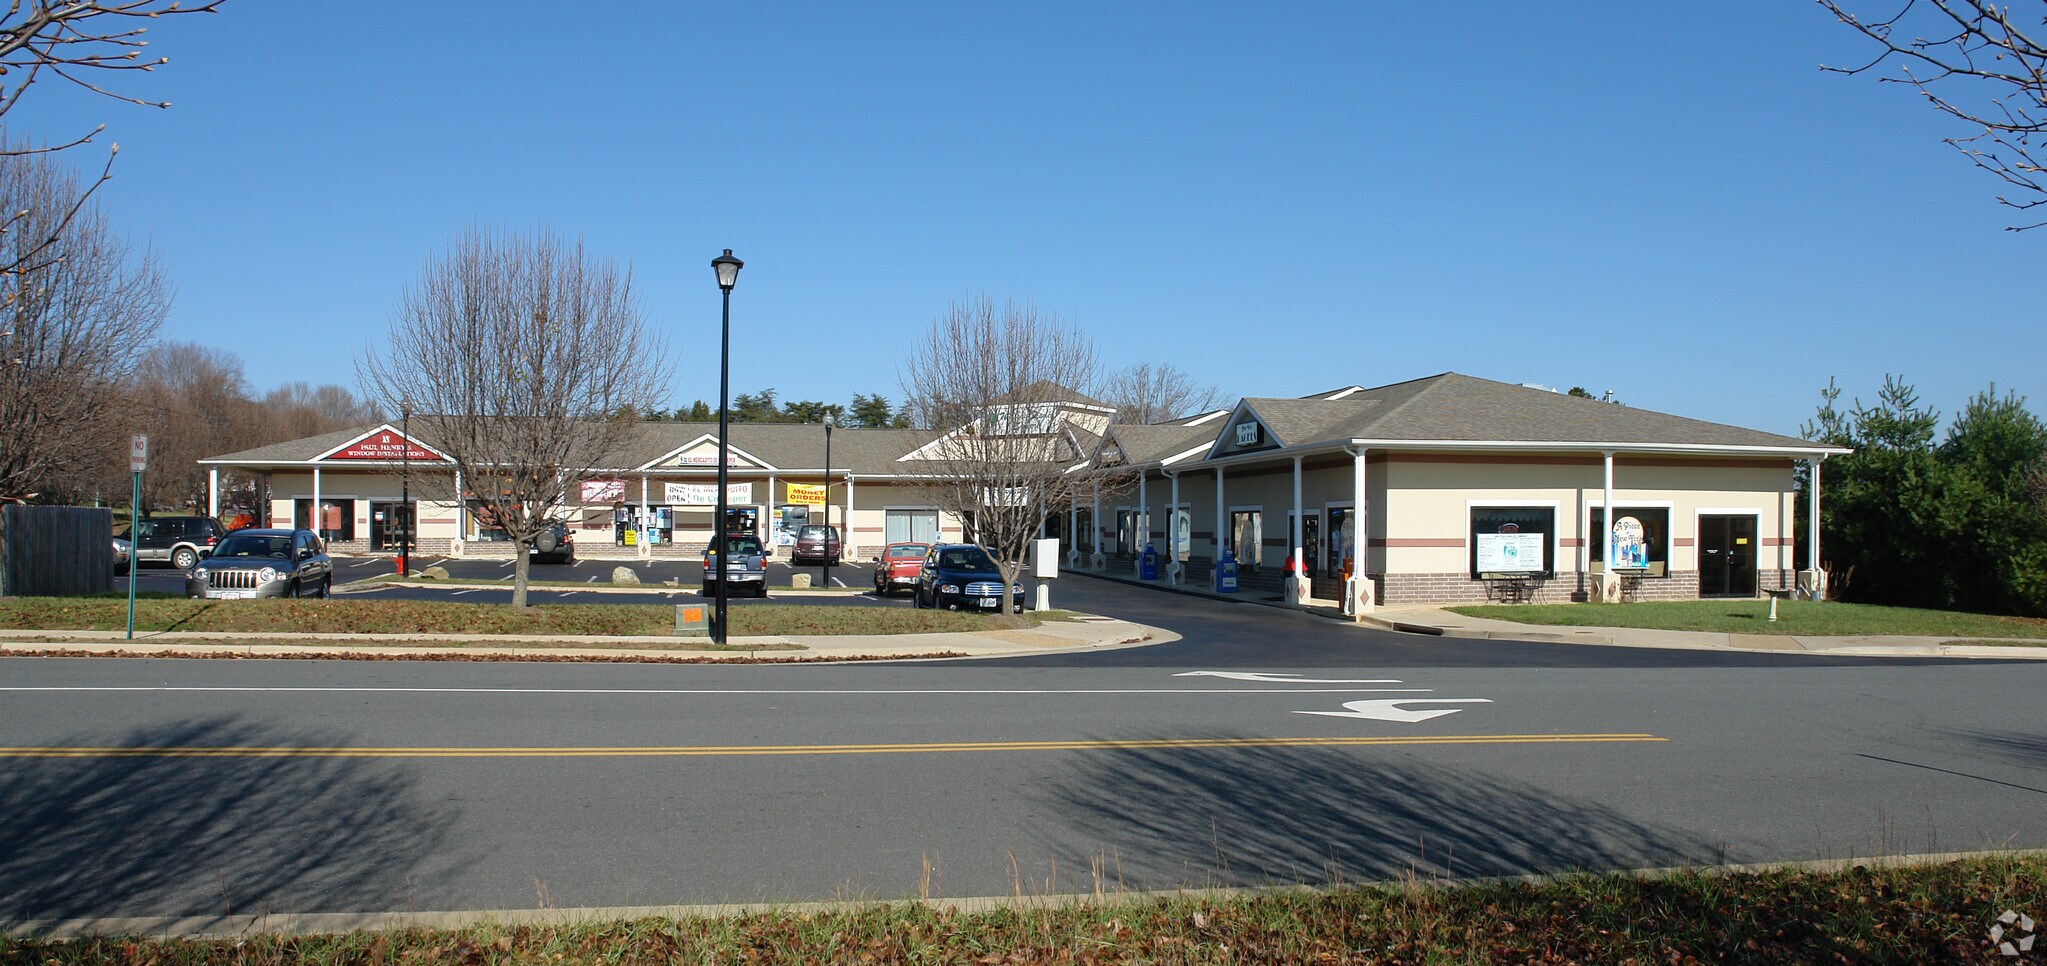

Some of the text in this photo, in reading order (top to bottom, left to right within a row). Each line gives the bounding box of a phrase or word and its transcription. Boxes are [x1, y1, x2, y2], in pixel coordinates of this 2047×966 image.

[135, 441, 144, 450] NO
[667, 494, 686, 502] OPEN
[790, 494, 826, 502] ORDERS
